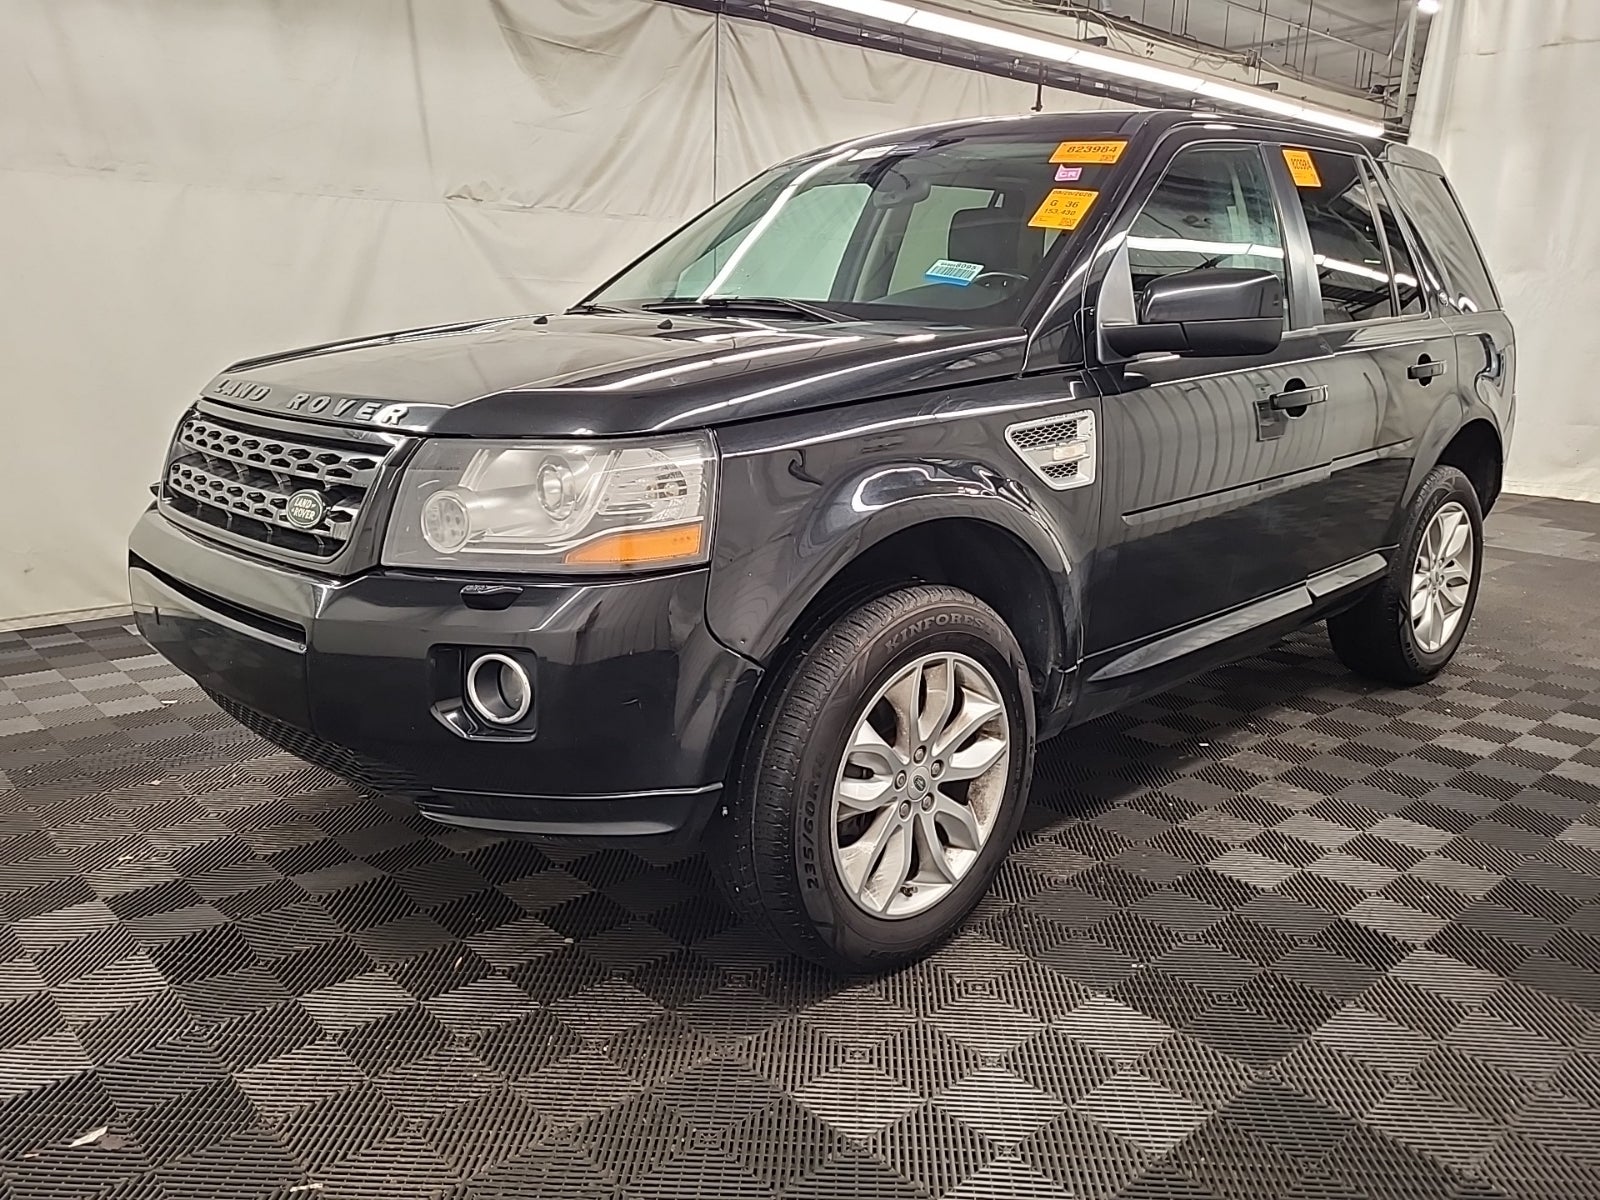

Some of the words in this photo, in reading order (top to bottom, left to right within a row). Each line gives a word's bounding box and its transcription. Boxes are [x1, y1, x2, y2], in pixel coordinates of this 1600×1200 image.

[1059, 170, 1077, 178] CR
[1050, 199, 1059, 207] G
[1065, 200, 1080, 208] 36
[214, 378, 273, 402] LAND
[285, 392, 410, 426] ROVER
[294, 497, 313, 509] LAND
[293, 506, 316, 521] ROVER
[884, 612, 996, 654] KINFOREST
